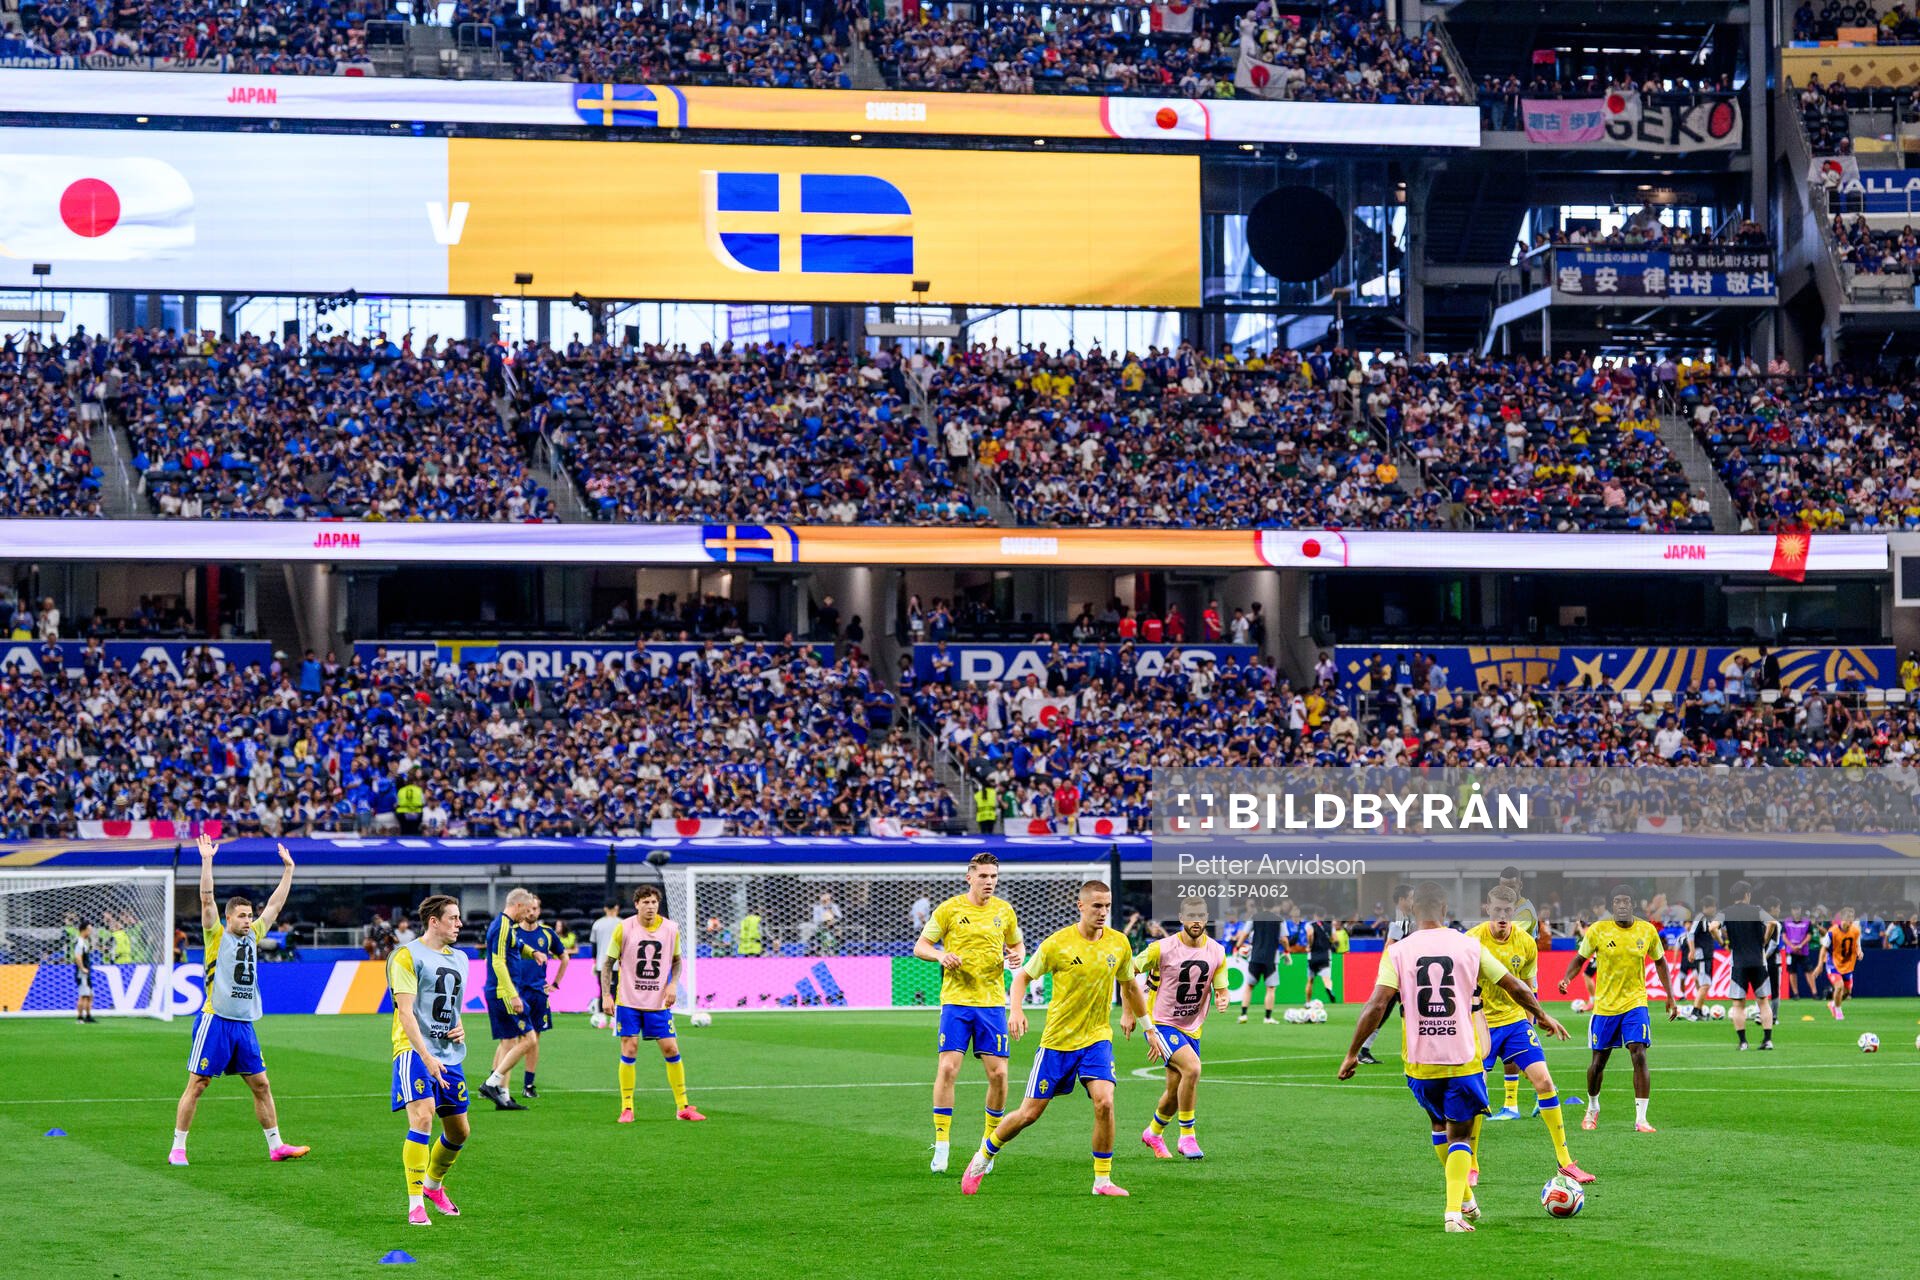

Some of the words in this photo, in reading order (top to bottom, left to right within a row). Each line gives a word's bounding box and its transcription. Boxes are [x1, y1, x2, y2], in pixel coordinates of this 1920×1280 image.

[227, 87, 277, 104] JAPAN
[865, 102, 926, 121] SWEDEN
[314, 532, 360, 549] JAPAN
[1663, 544, 1705, 560] JAPAN
[92, 963, 205, 1015] VIS
[231, 991, 253, 1000] 2026
[1428, 1004, 1447, 1013] FIFA
[1418, 1027, 1457, 1036] 2026
[996, 1034, 1009, 1052] 17
